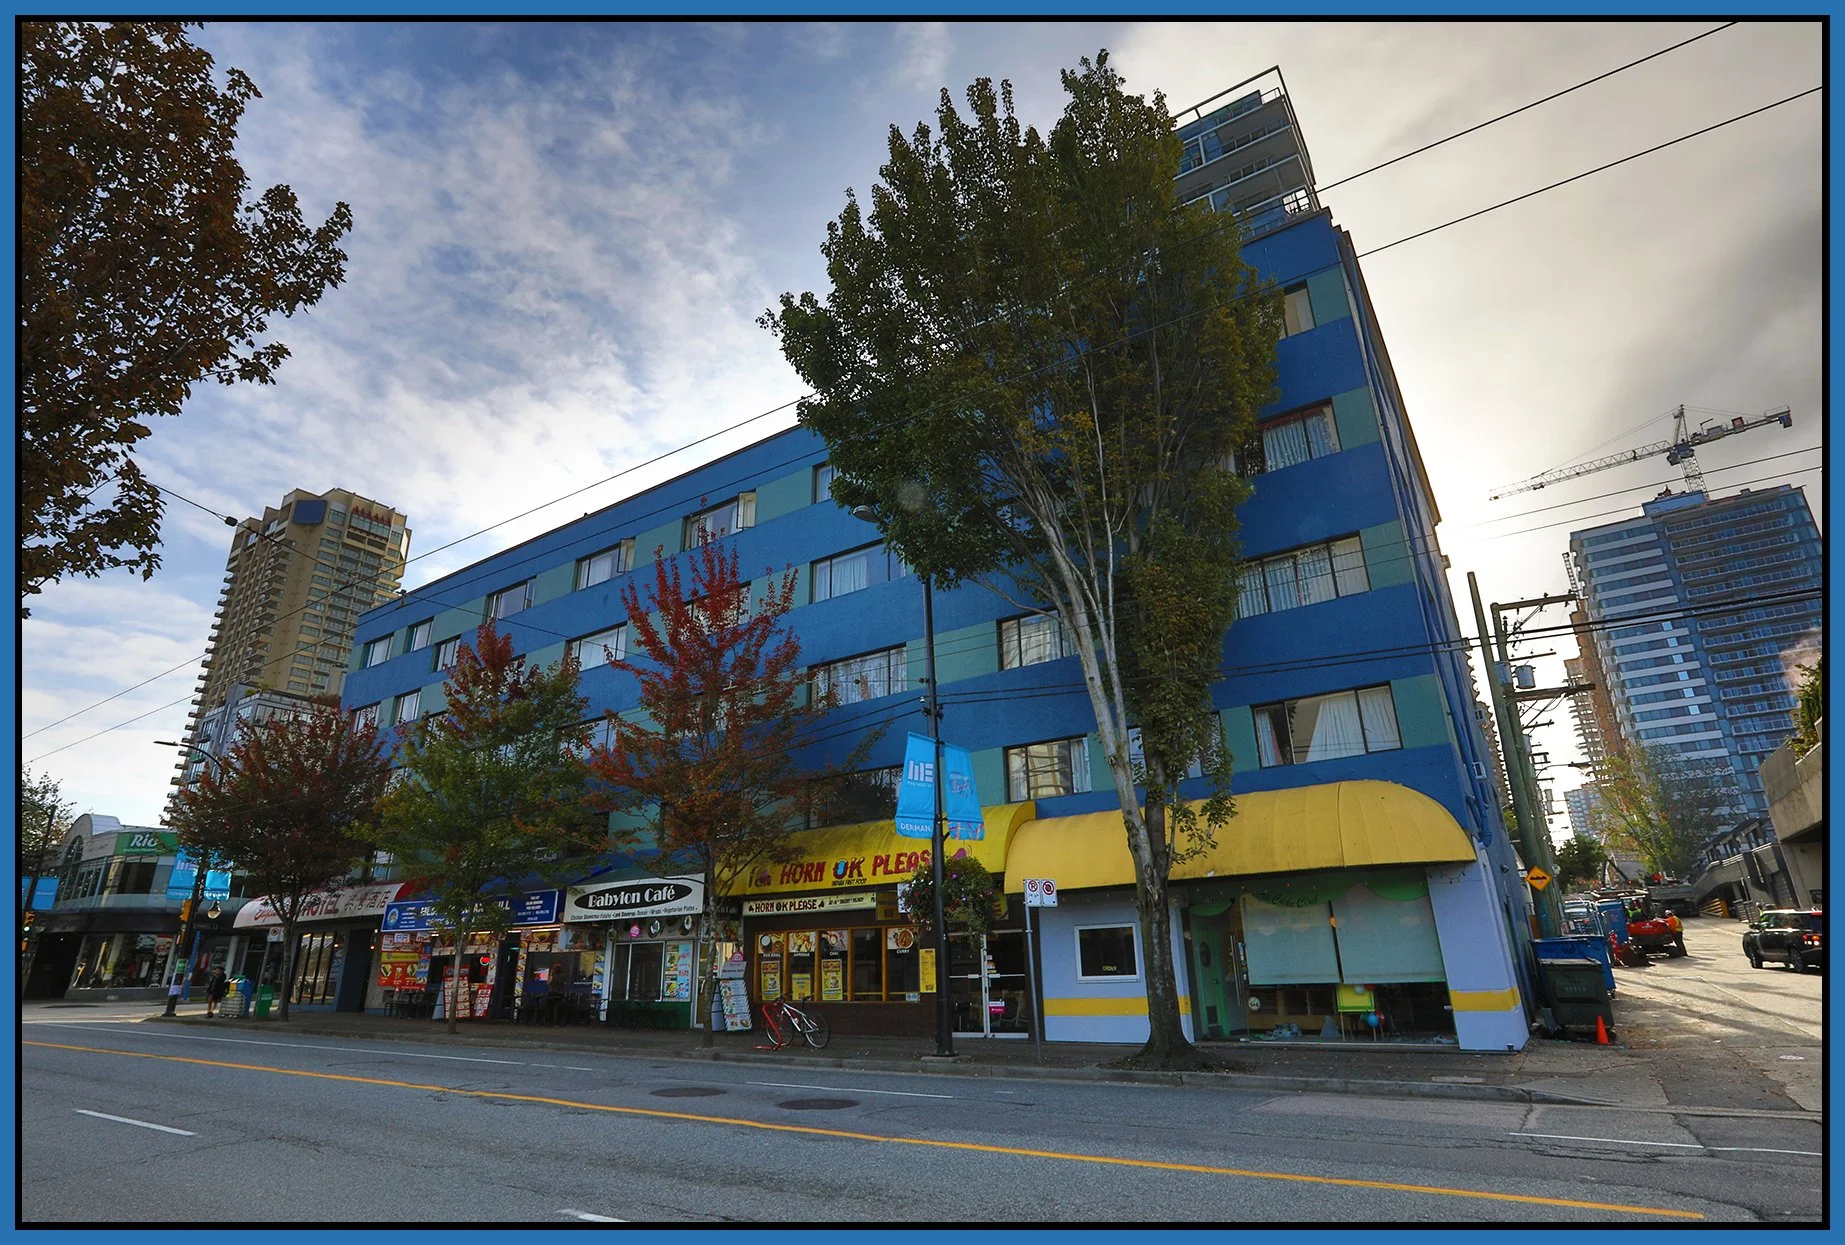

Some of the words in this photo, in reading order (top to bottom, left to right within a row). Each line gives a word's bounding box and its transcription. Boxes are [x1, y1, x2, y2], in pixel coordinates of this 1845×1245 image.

[130, 834, 157, 847] Rio
[779, 861, 825, 885] HORN
[833, 857, 865, 880] OK
[871, 850, 931, 876] PLEAS
[588, 891, 640, 908] Babylon
[644, 885, 675, 902] Café
[754, 903, 774, 913] HORN
[775, 902, 788, 911] OK
[789, 900, 817, 911] PLEASE
